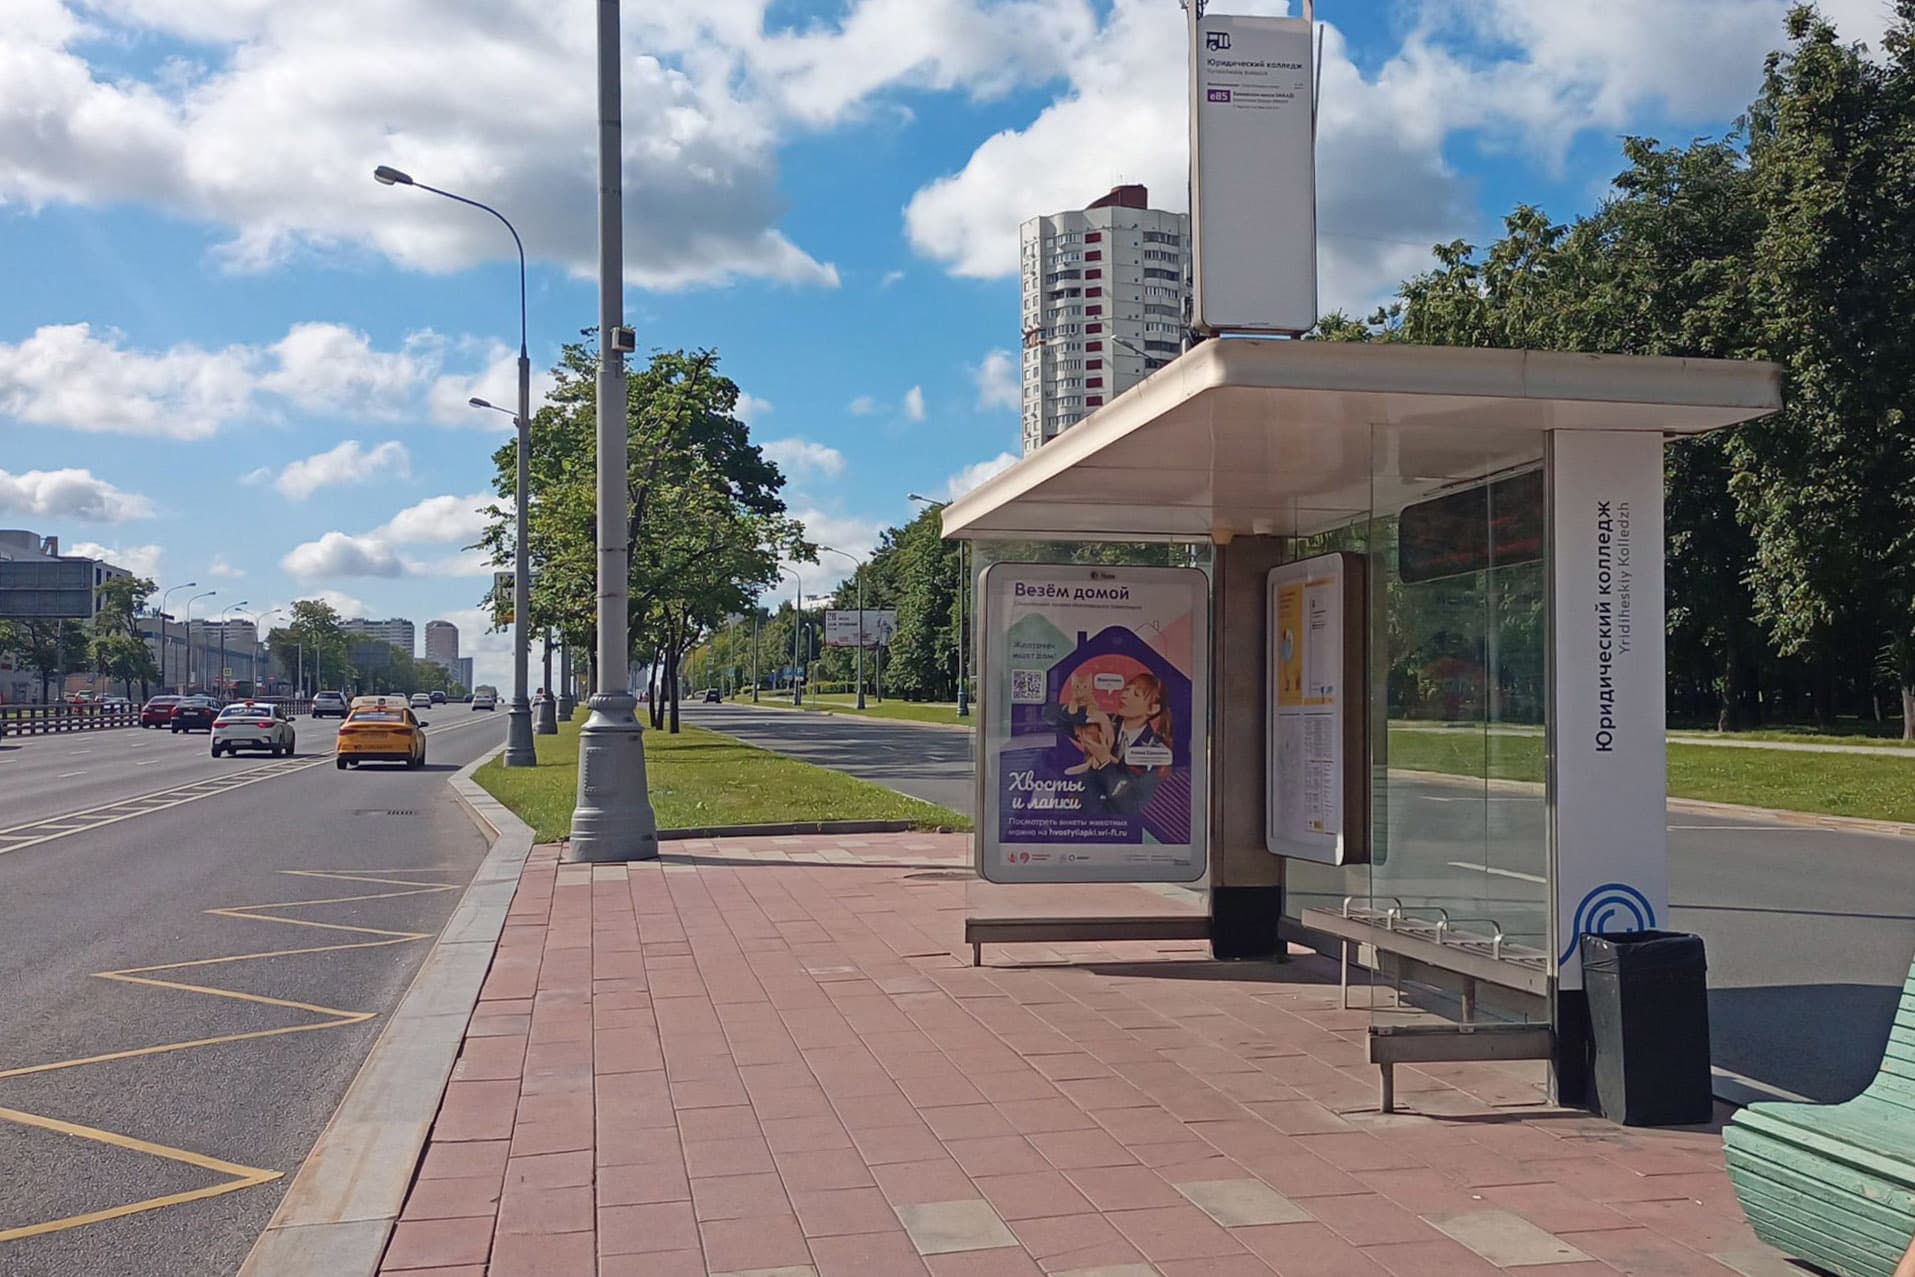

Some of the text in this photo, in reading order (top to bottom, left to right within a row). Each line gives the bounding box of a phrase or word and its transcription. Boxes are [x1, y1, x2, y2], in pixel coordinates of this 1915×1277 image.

[1207, 58, 1303, 70] Юридический колледж
[1617, 501, 1633, 655] Yridiheskiy Kolledzh
[1014, 582, 1130, 600] Везём домой
[1595, 500, 1616, 752] Юридический колледж
[1008, 770, 1086, 791] Хвосты
[1012, 797, 1082, 809] и лапки
[1008, 817, 1058, 827] Посмотреть
